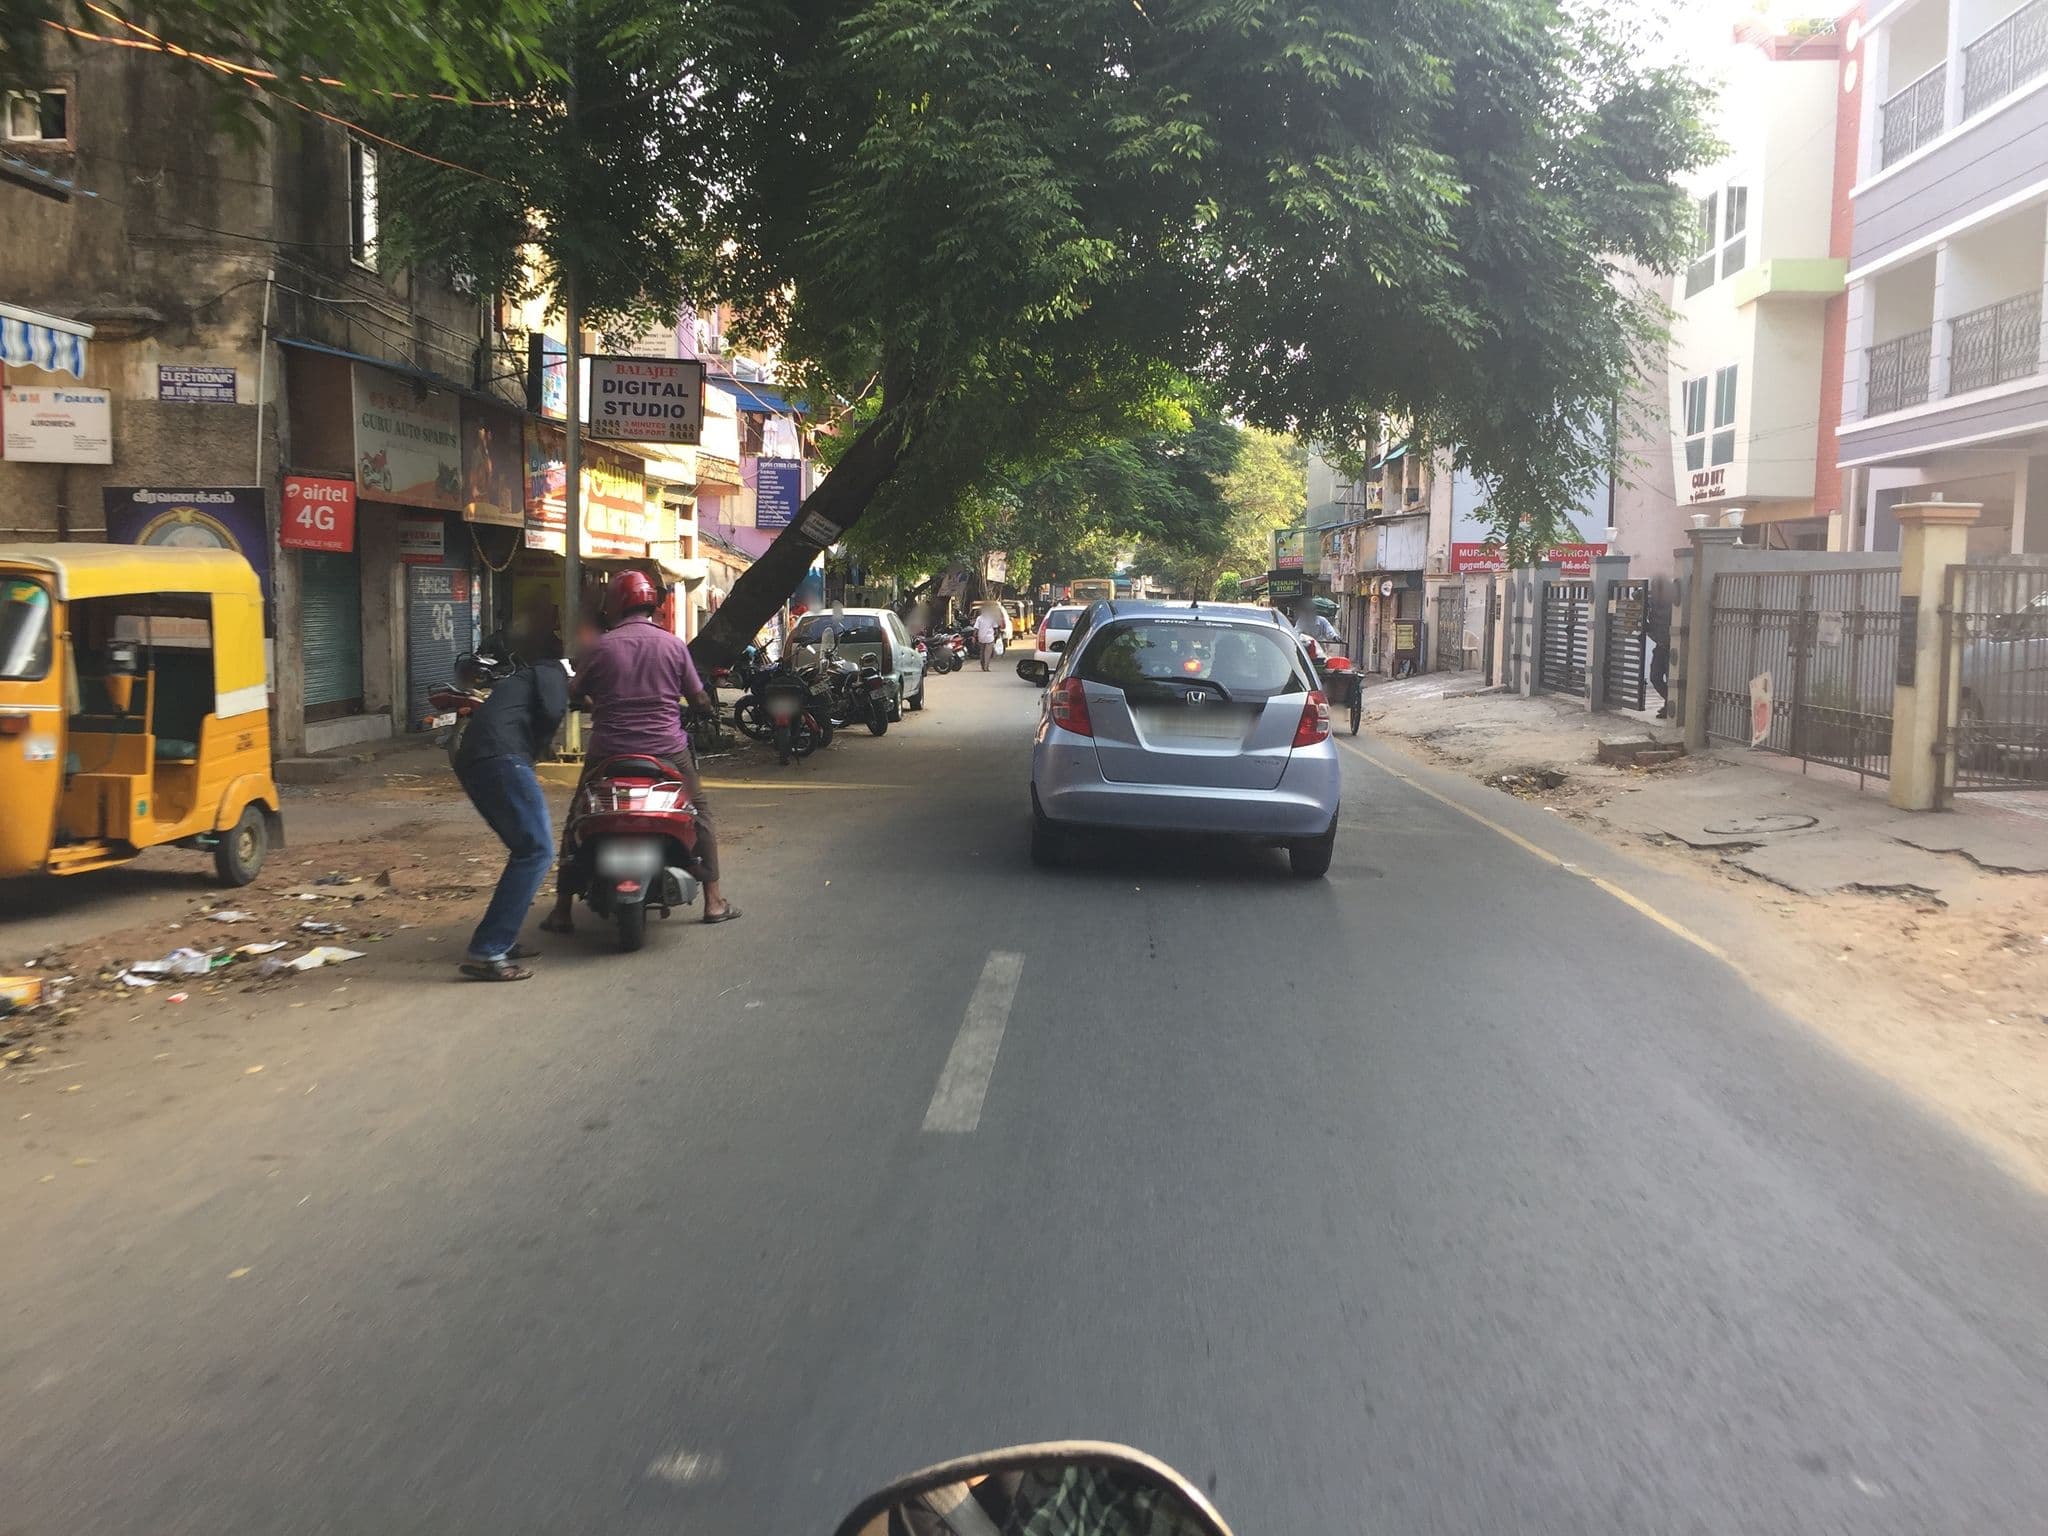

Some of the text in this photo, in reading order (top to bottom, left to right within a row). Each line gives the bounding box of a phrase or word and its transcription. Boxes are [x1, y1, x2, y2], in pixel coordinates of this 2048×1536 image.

[160, 371, 234, 383] ELECTRONIC
[616, 365, 678, 379] BALAJEE
[603, 380, 689, 398] DIGITAL
[65, 396, 104, 404] DAIKIN
[604, 401, 685, 418] STUDIO
[362, 413, 392, 433] GURU
[394, 421, 420, 440] AUTO
[303, 484, 348, 503] airtel
[297, 506, 335, 530] 4G
